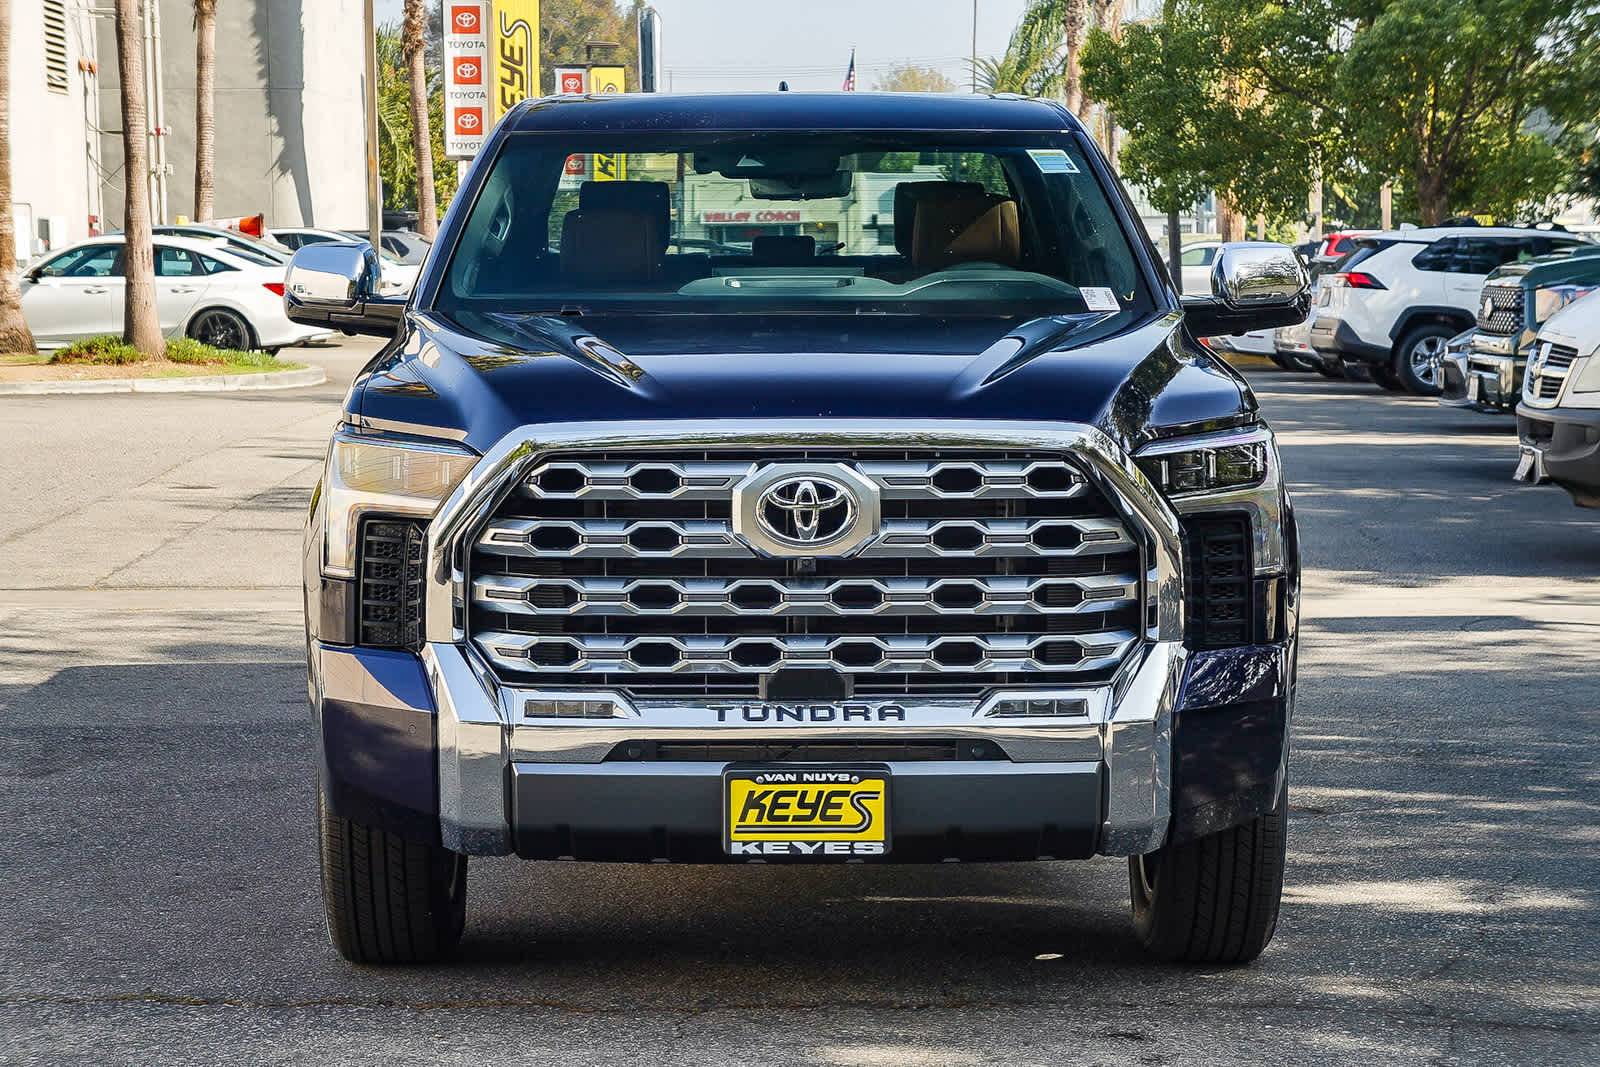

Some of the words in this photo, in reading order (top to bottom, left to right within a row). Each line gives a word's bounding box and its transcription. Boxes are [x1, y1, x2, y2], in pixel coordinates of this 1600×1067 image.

[448, 41, 486, 49] TOYOTA
[499, 10, 532, 113] EYES
[449, 91, 487, 99] TOYOTA
[450, 142, 482, 150] TOYOT
[704, 211, 750, 222] VALLEY
[756, 210, 800, 222] COACH
[706, 704, 906, 722] TUNDRA
[763, 773, 797, 782] VAN
[803, 773, 850, 782] NUYS
[733, 789, 881, 833] KEYES
[731, 841, 884, 855] KEYES
